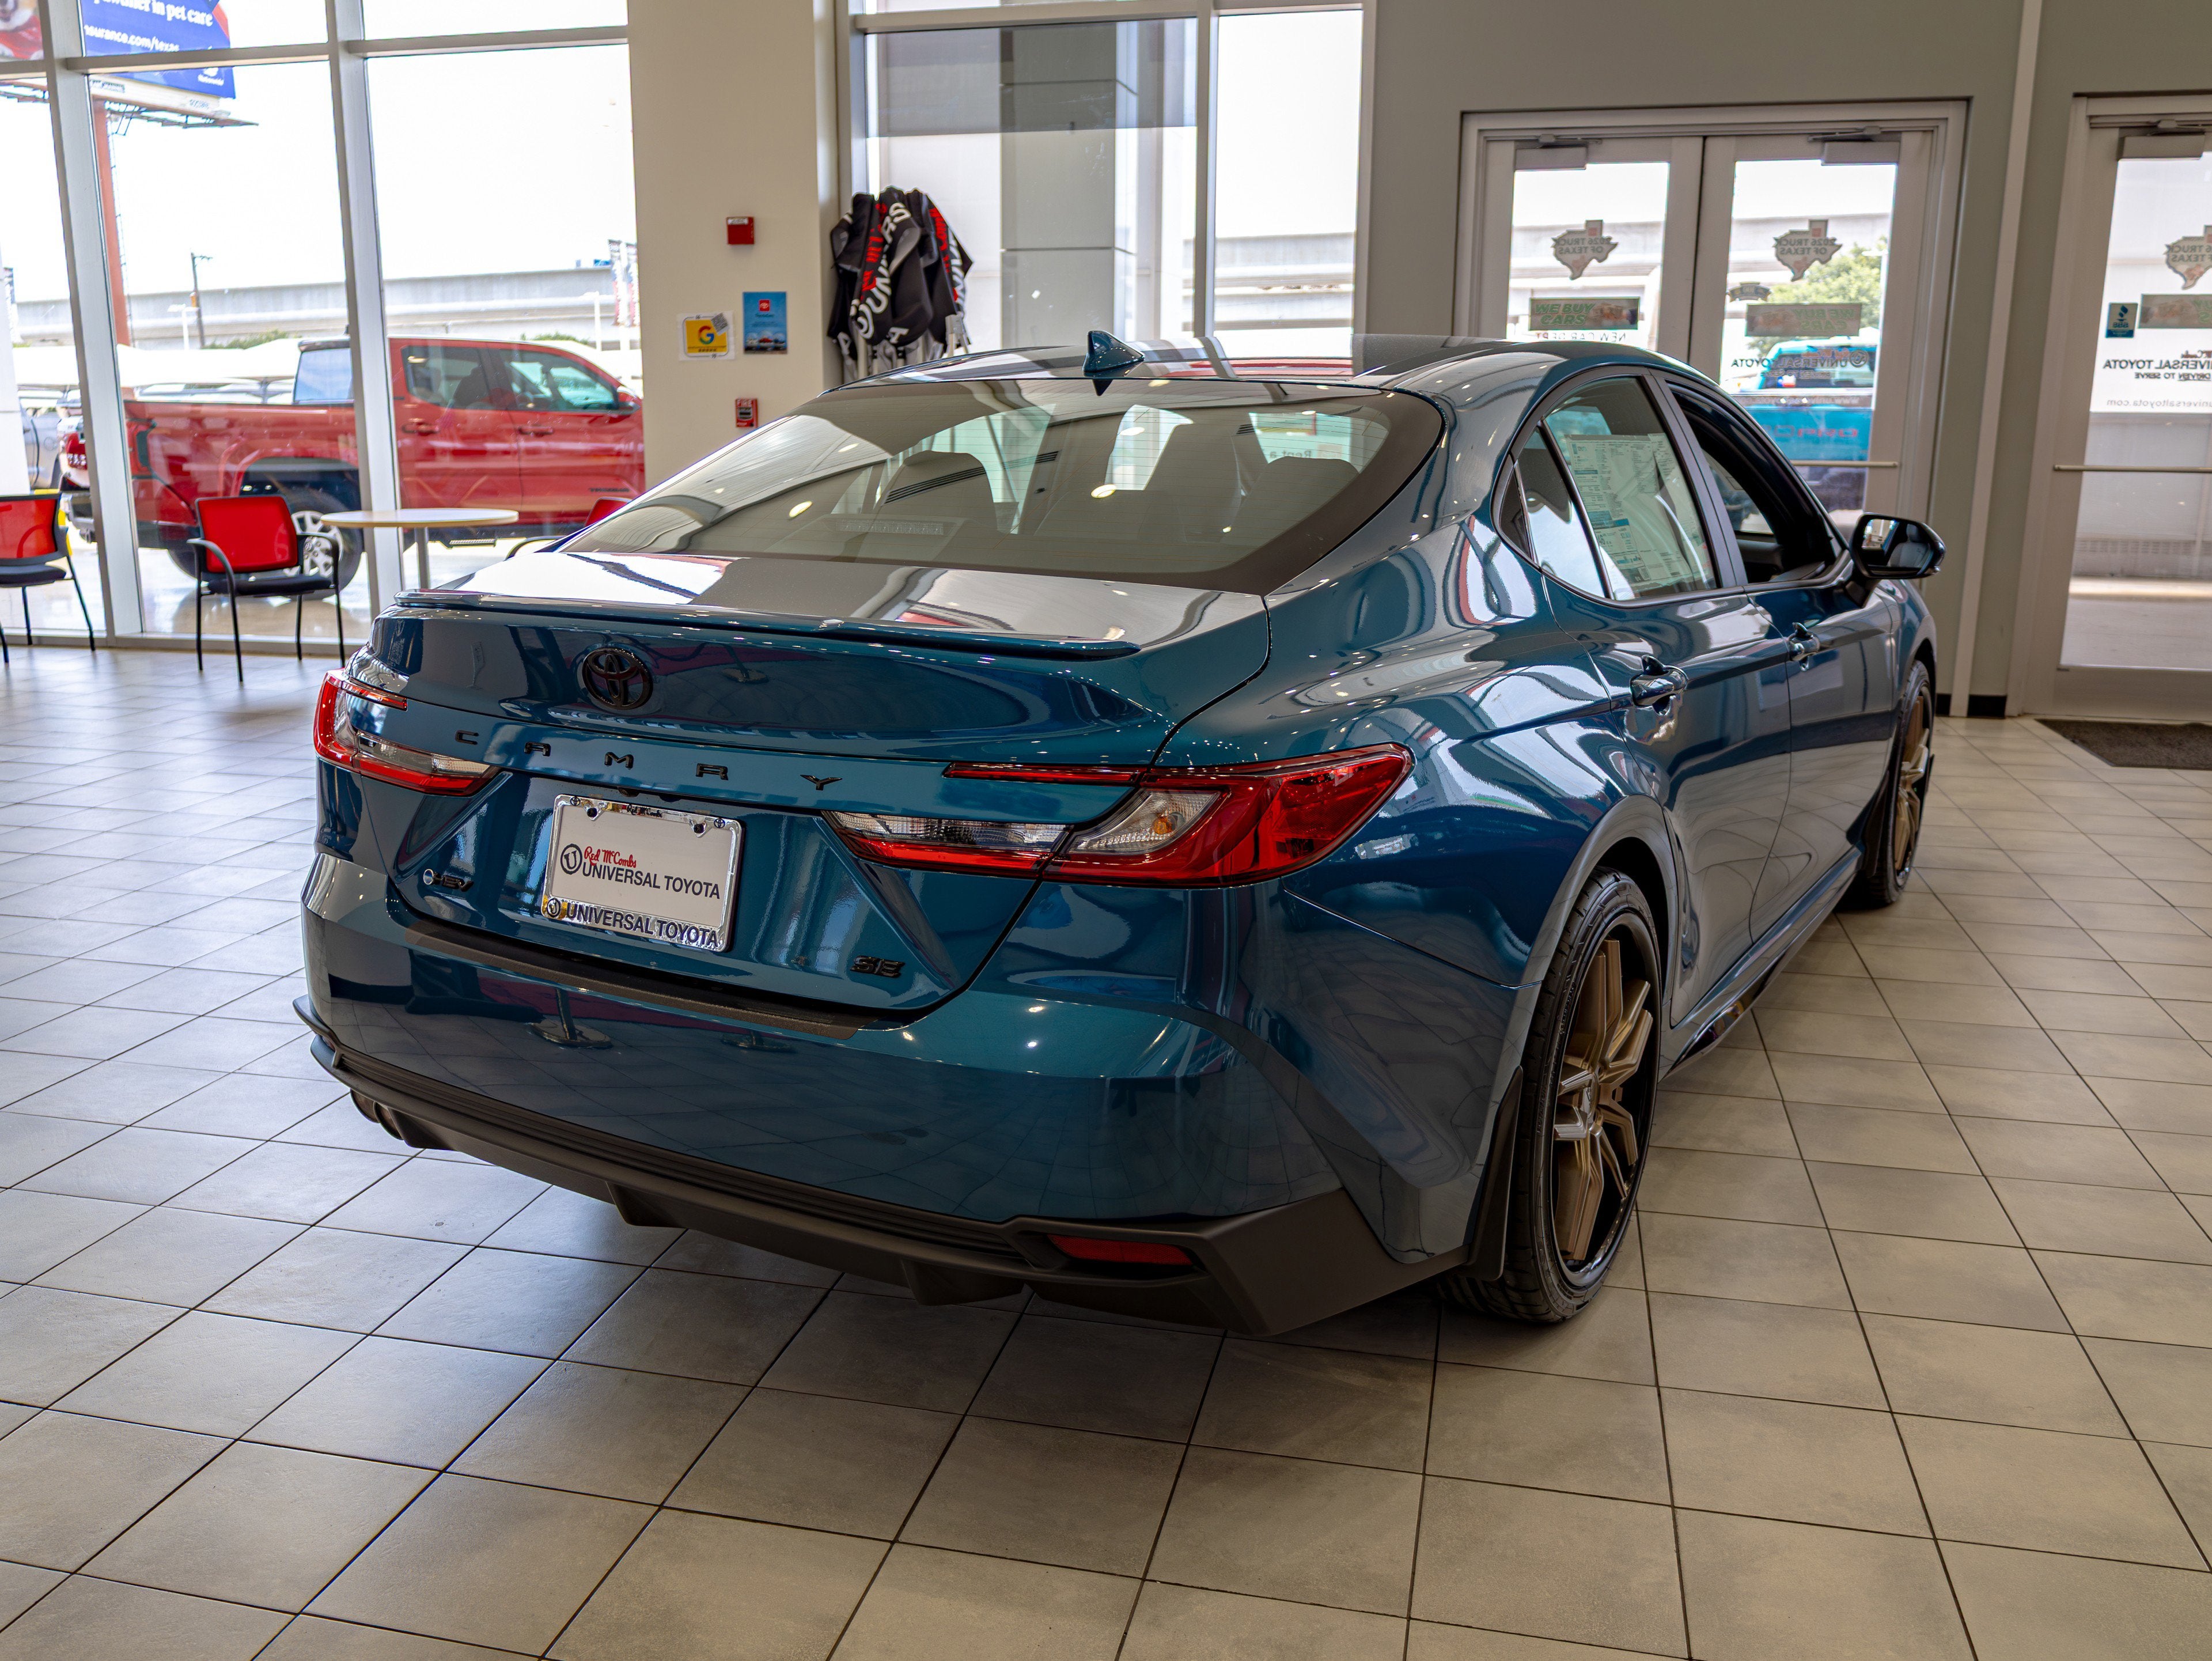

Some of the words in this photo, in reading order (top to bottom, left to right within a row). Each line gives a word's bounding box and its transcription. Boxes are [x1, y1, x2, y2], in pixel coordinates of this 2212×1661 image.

[152, 2, 165, 16] in
[166, 5, 187, 21] pet
[187, 9, 213, 27] care
[1536, 303, 1560, 313] WE
[1562, 303, 1595, 313] BUY
[1540, 314, 1586, 326] CARS
[454, 729, 843, 791] CAMRY
[584, 846, 601, 867] Red
[602, 849, 637, 868] McCombs
[583, 862, 661, 890] UNIVERSAL
[664, 875, 721, 900] TOYOTA
[566, 902, 656, 936] UNIVERSAL
[657, 919, 719, 948] TOYOTA
[850, 955, 906, 978] SE
